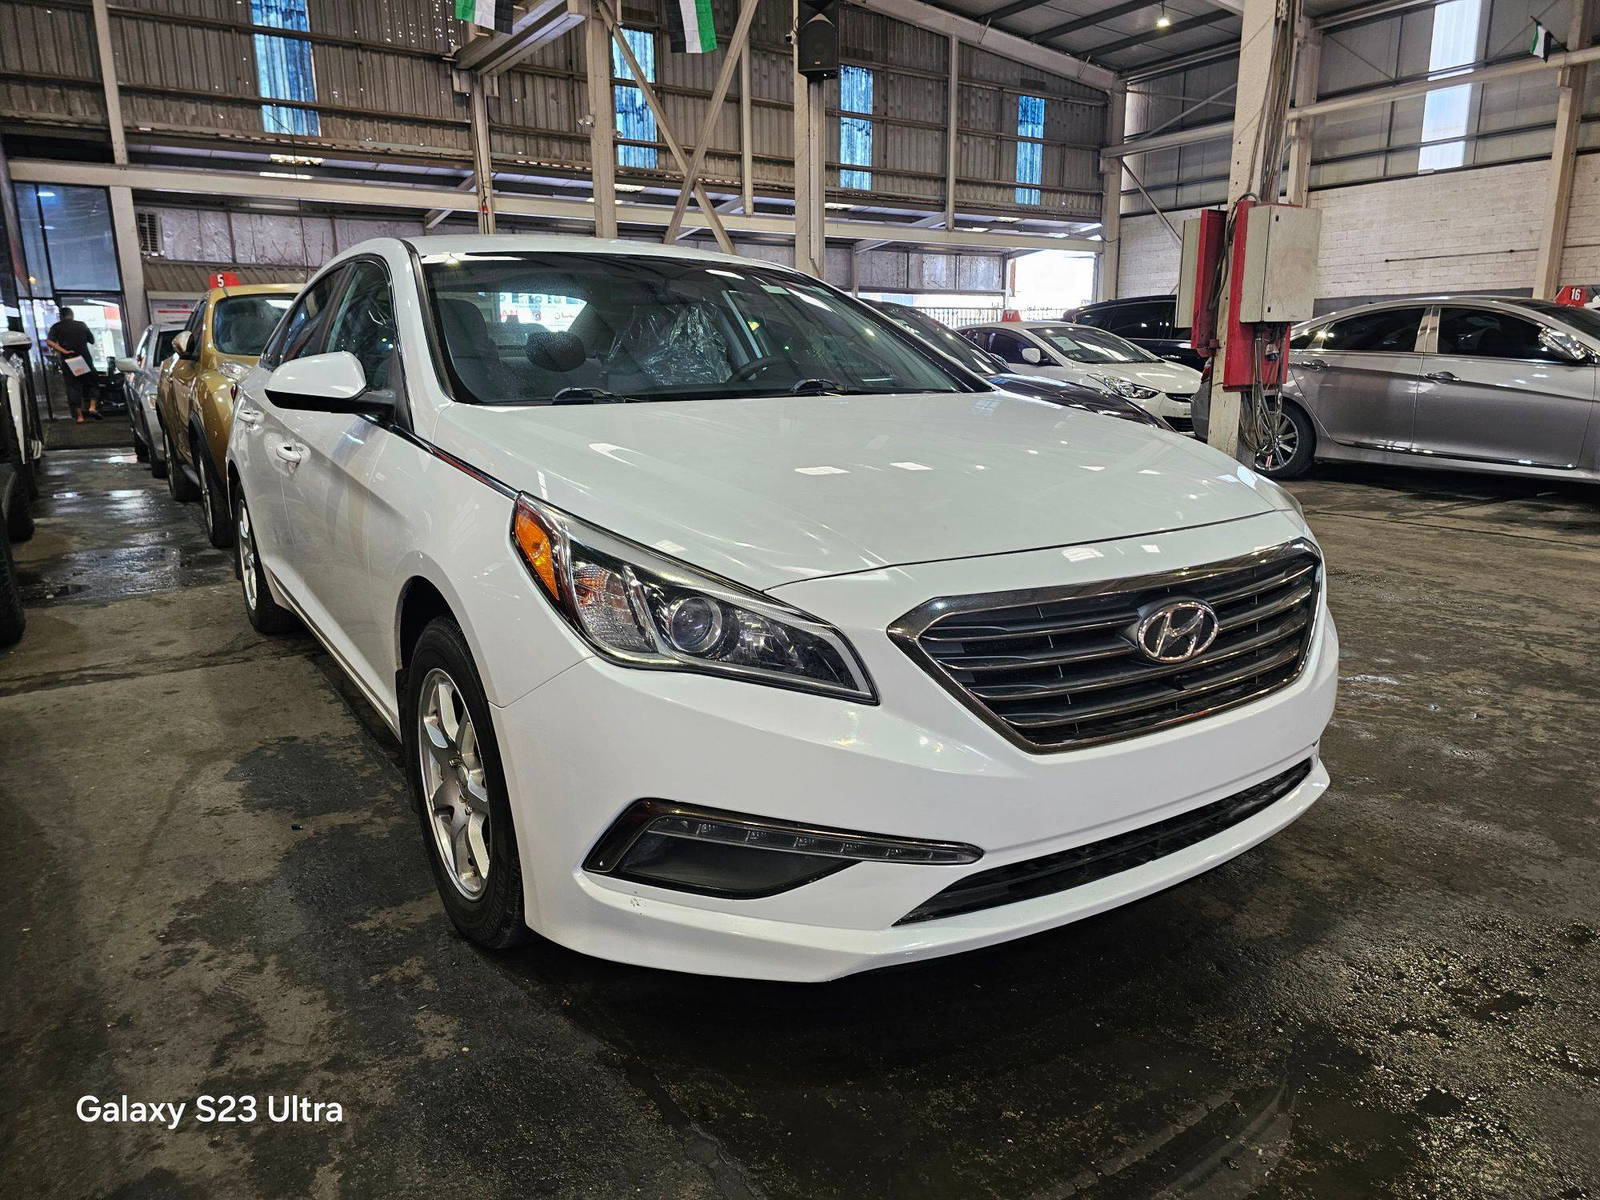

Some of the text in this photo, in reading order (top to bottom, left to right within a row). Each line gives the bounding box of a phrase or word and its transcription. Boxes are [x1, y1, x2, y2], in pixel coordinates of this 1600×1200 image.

[217, 273, 225, 288] 5
[1571, 287, 1582, 301] 16
[1006, 311, 1016, 320] 17
